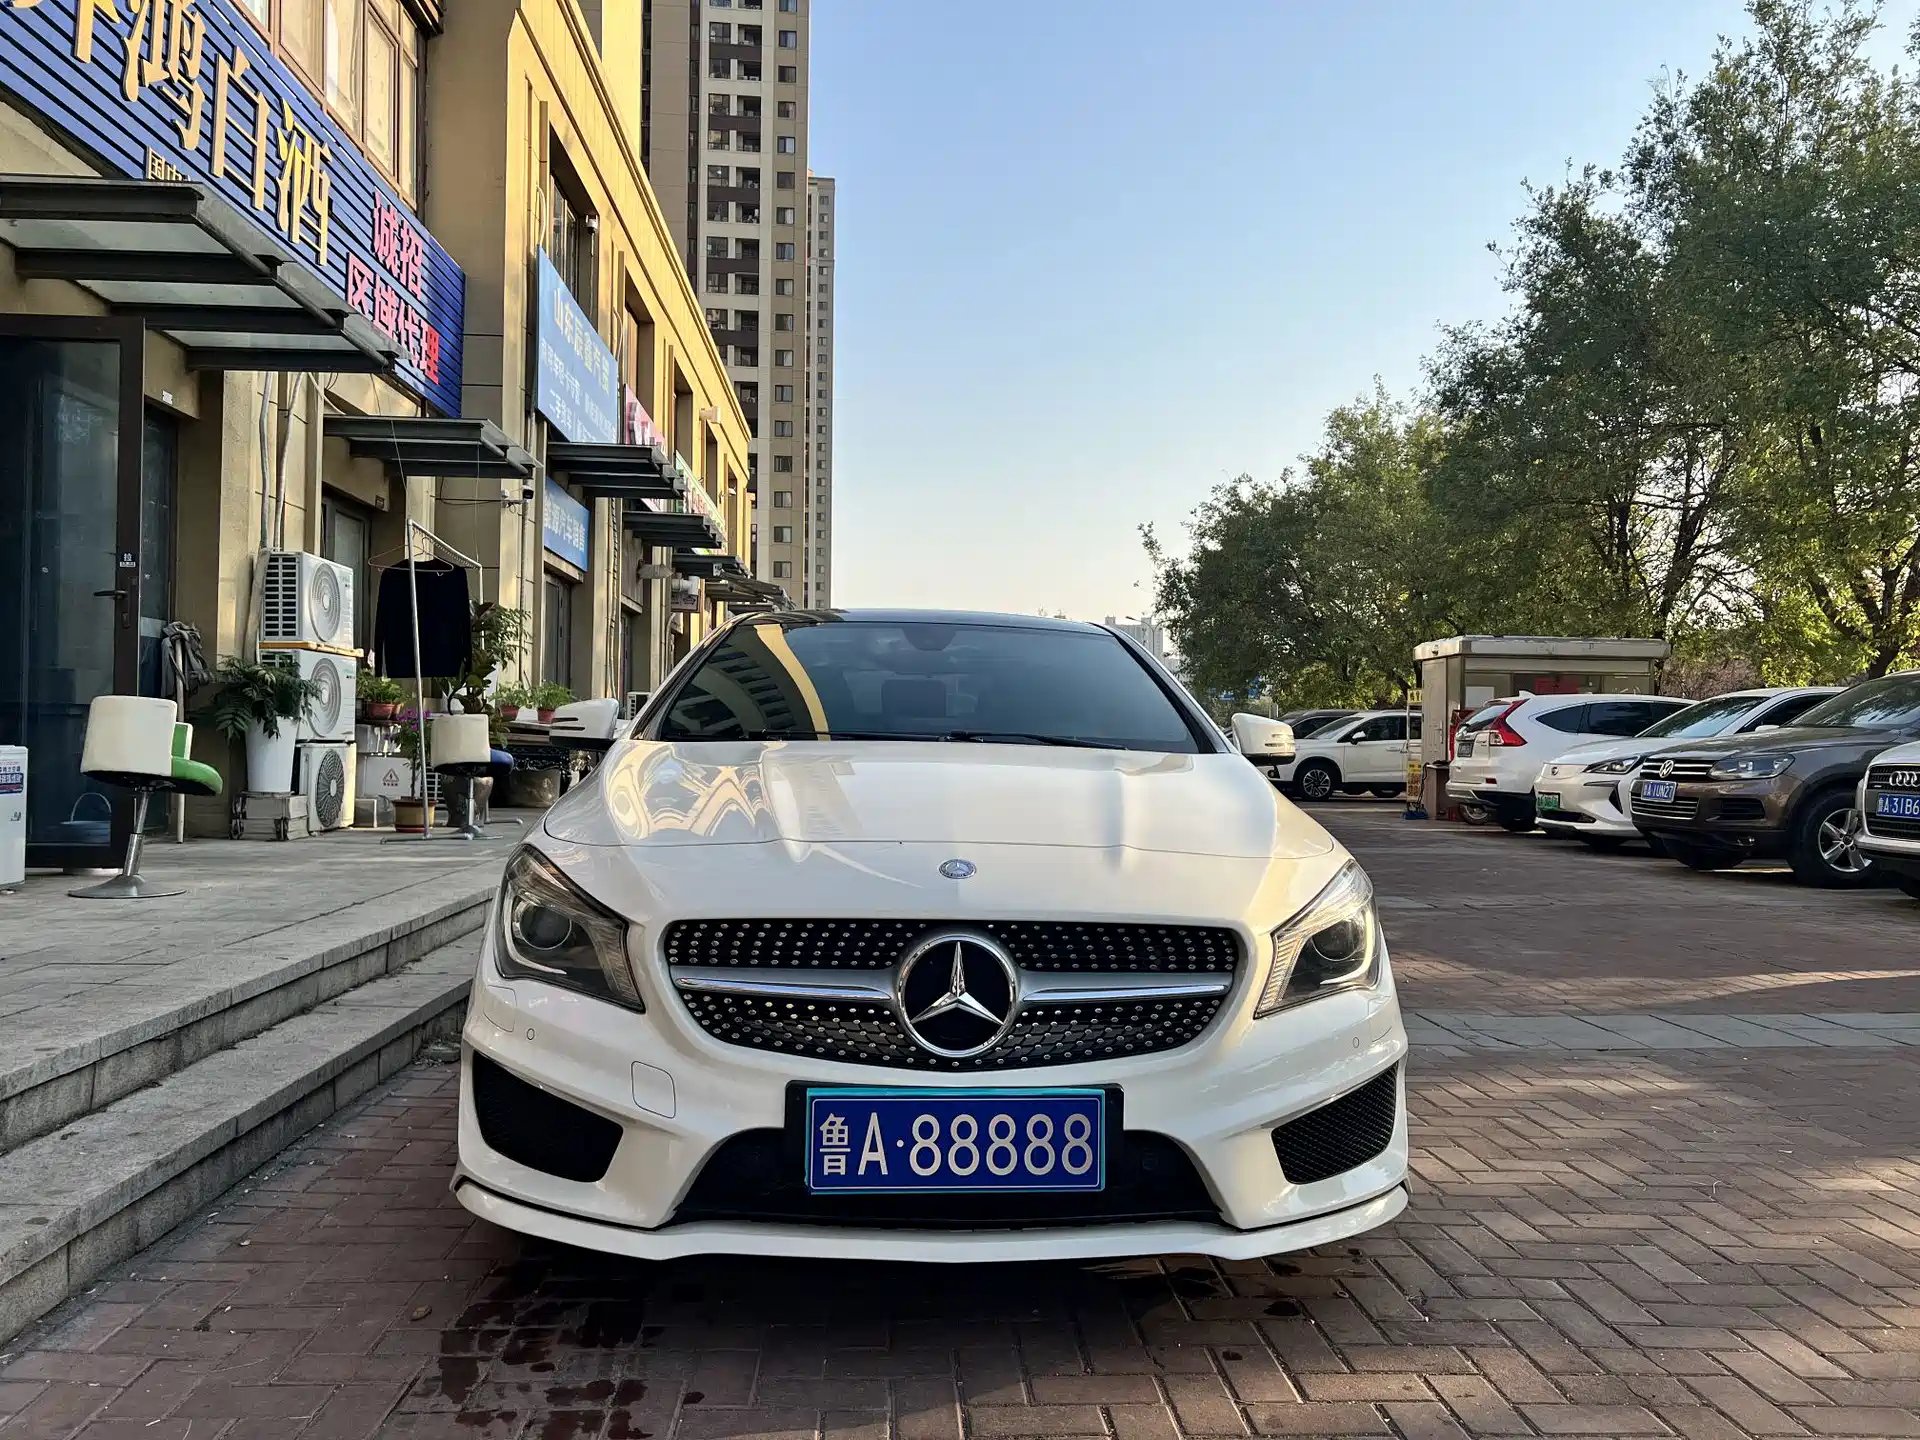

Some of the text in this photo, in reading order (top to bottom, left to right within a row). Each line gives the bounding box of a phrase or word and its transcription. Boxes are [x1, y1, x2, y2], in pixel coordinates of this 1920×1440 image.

[373, 190, 423, 301] 诚招
[346, 250, 440, 385] 区域代理
[819, 1111, 1093, 1177] 鲁A·88888
